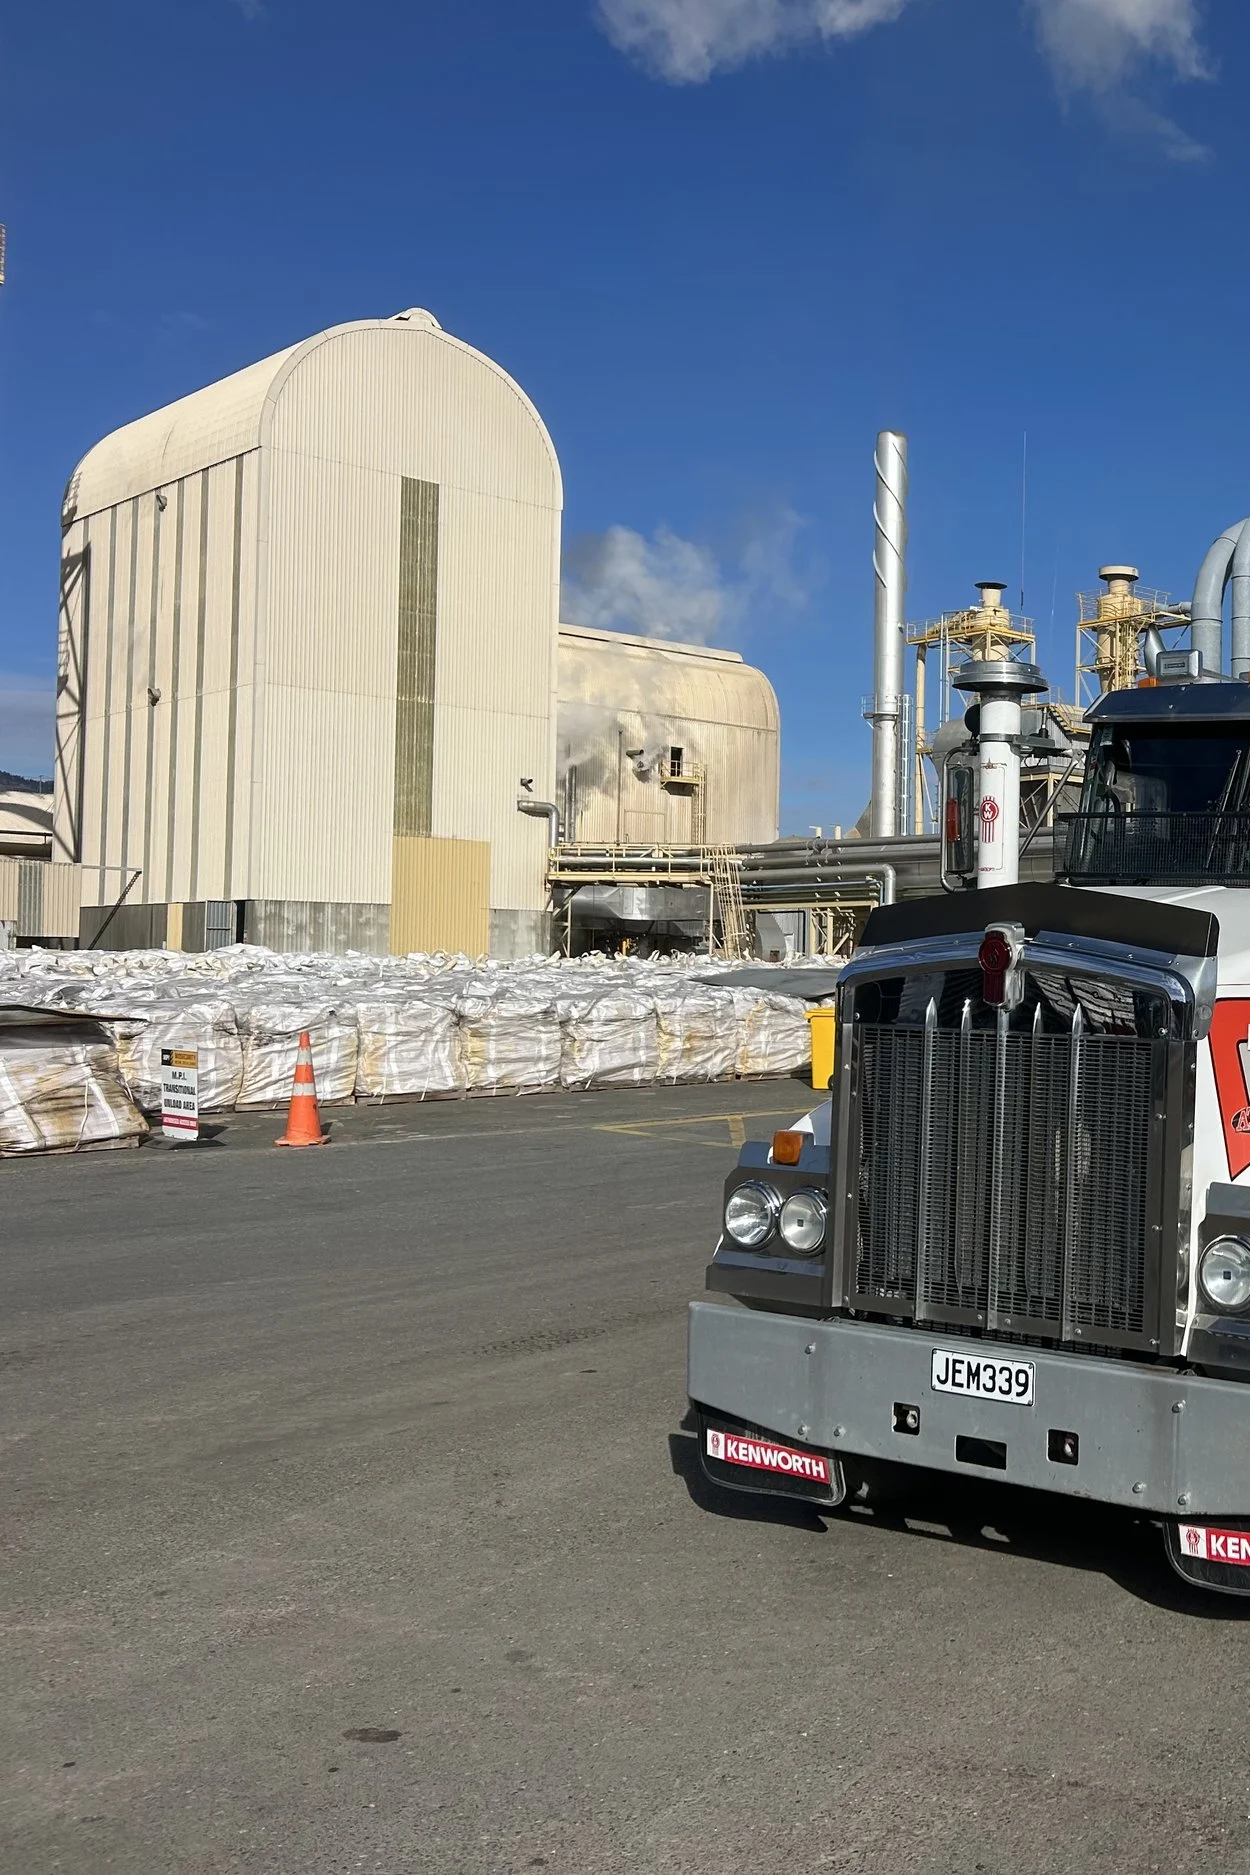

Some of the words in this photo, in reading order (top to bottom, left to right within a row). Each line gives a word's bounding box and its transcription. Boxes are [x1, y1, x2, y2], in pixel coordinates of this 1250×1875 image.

[171, 1070, 187, 1080] M.P.I.
[163, 1083, 196, 1095] TRANSITIONAL
[163, 1098, 182, 1109] UNLOAD
[183, 1100, 196, 1110] AREA
[936, 1360, 1029, 1398] JEM339
[727, 1439, 826, 1479] KENWORTH
